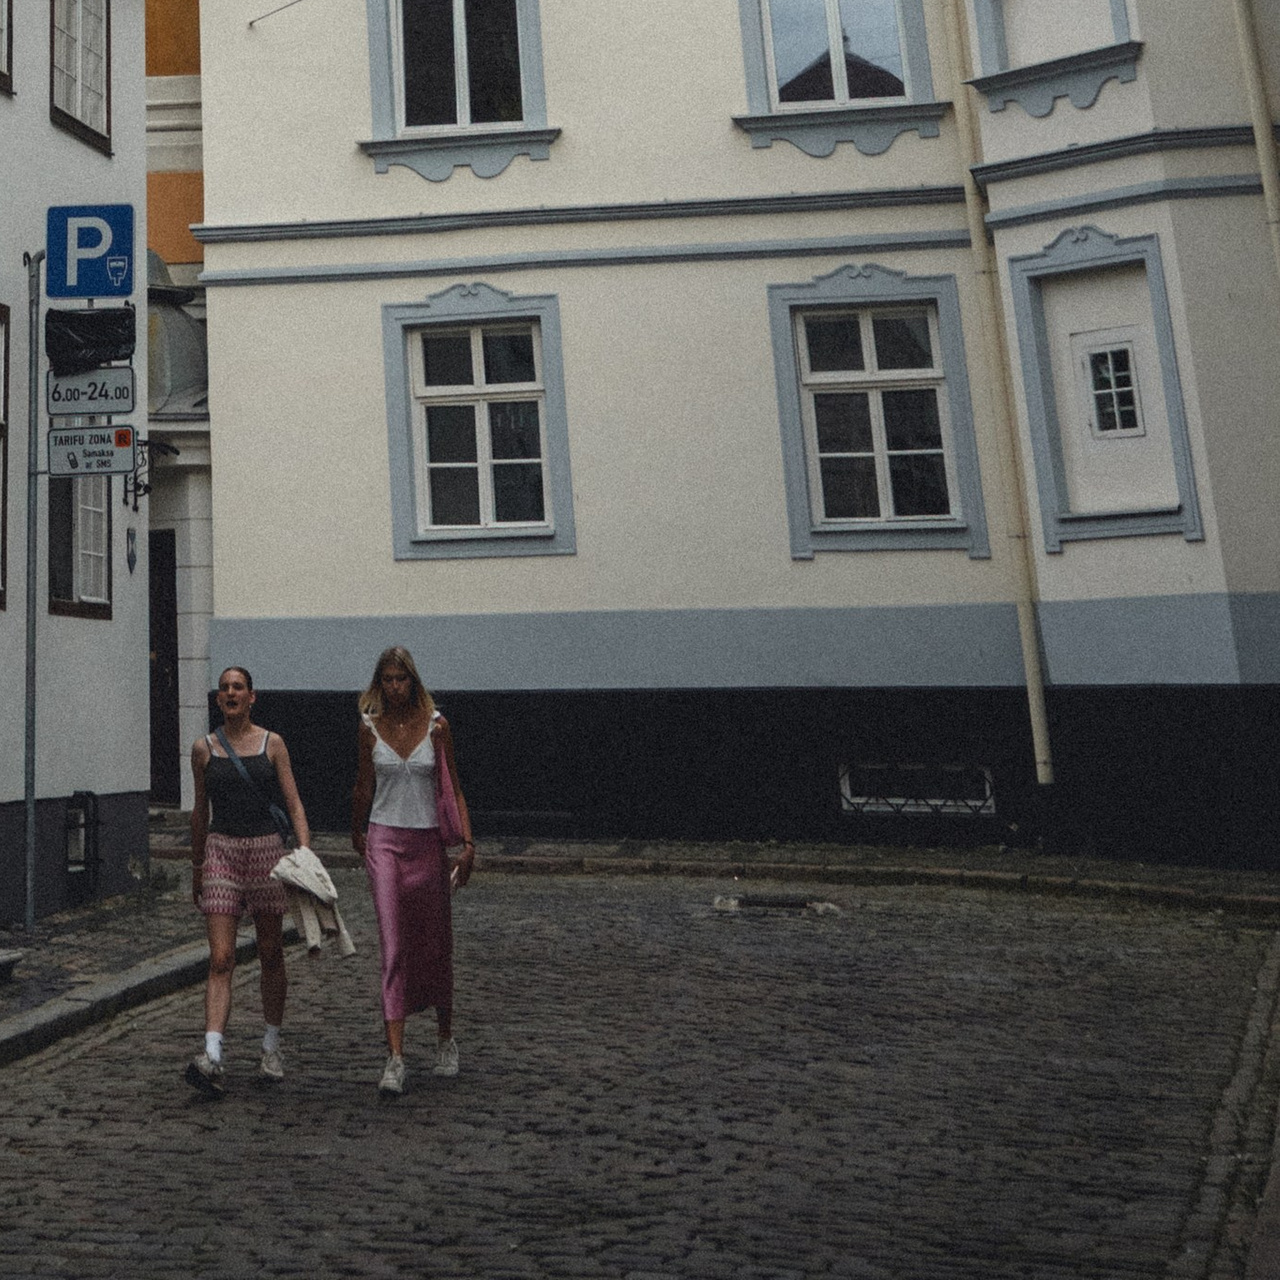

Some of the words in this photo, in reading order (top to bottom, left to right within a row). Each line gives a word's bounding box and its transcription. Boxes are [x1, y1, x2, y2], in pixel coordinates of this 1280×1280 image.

[67, 217, 113, 286] P
[52, 382, 129, 402] 6.00-24.00
[53, 435, 84, 446] TARIFU
[89, 434, 112, 444] ZONA
[118, 433, 127, 443] R
[96, 459, 112, 468] SMS
